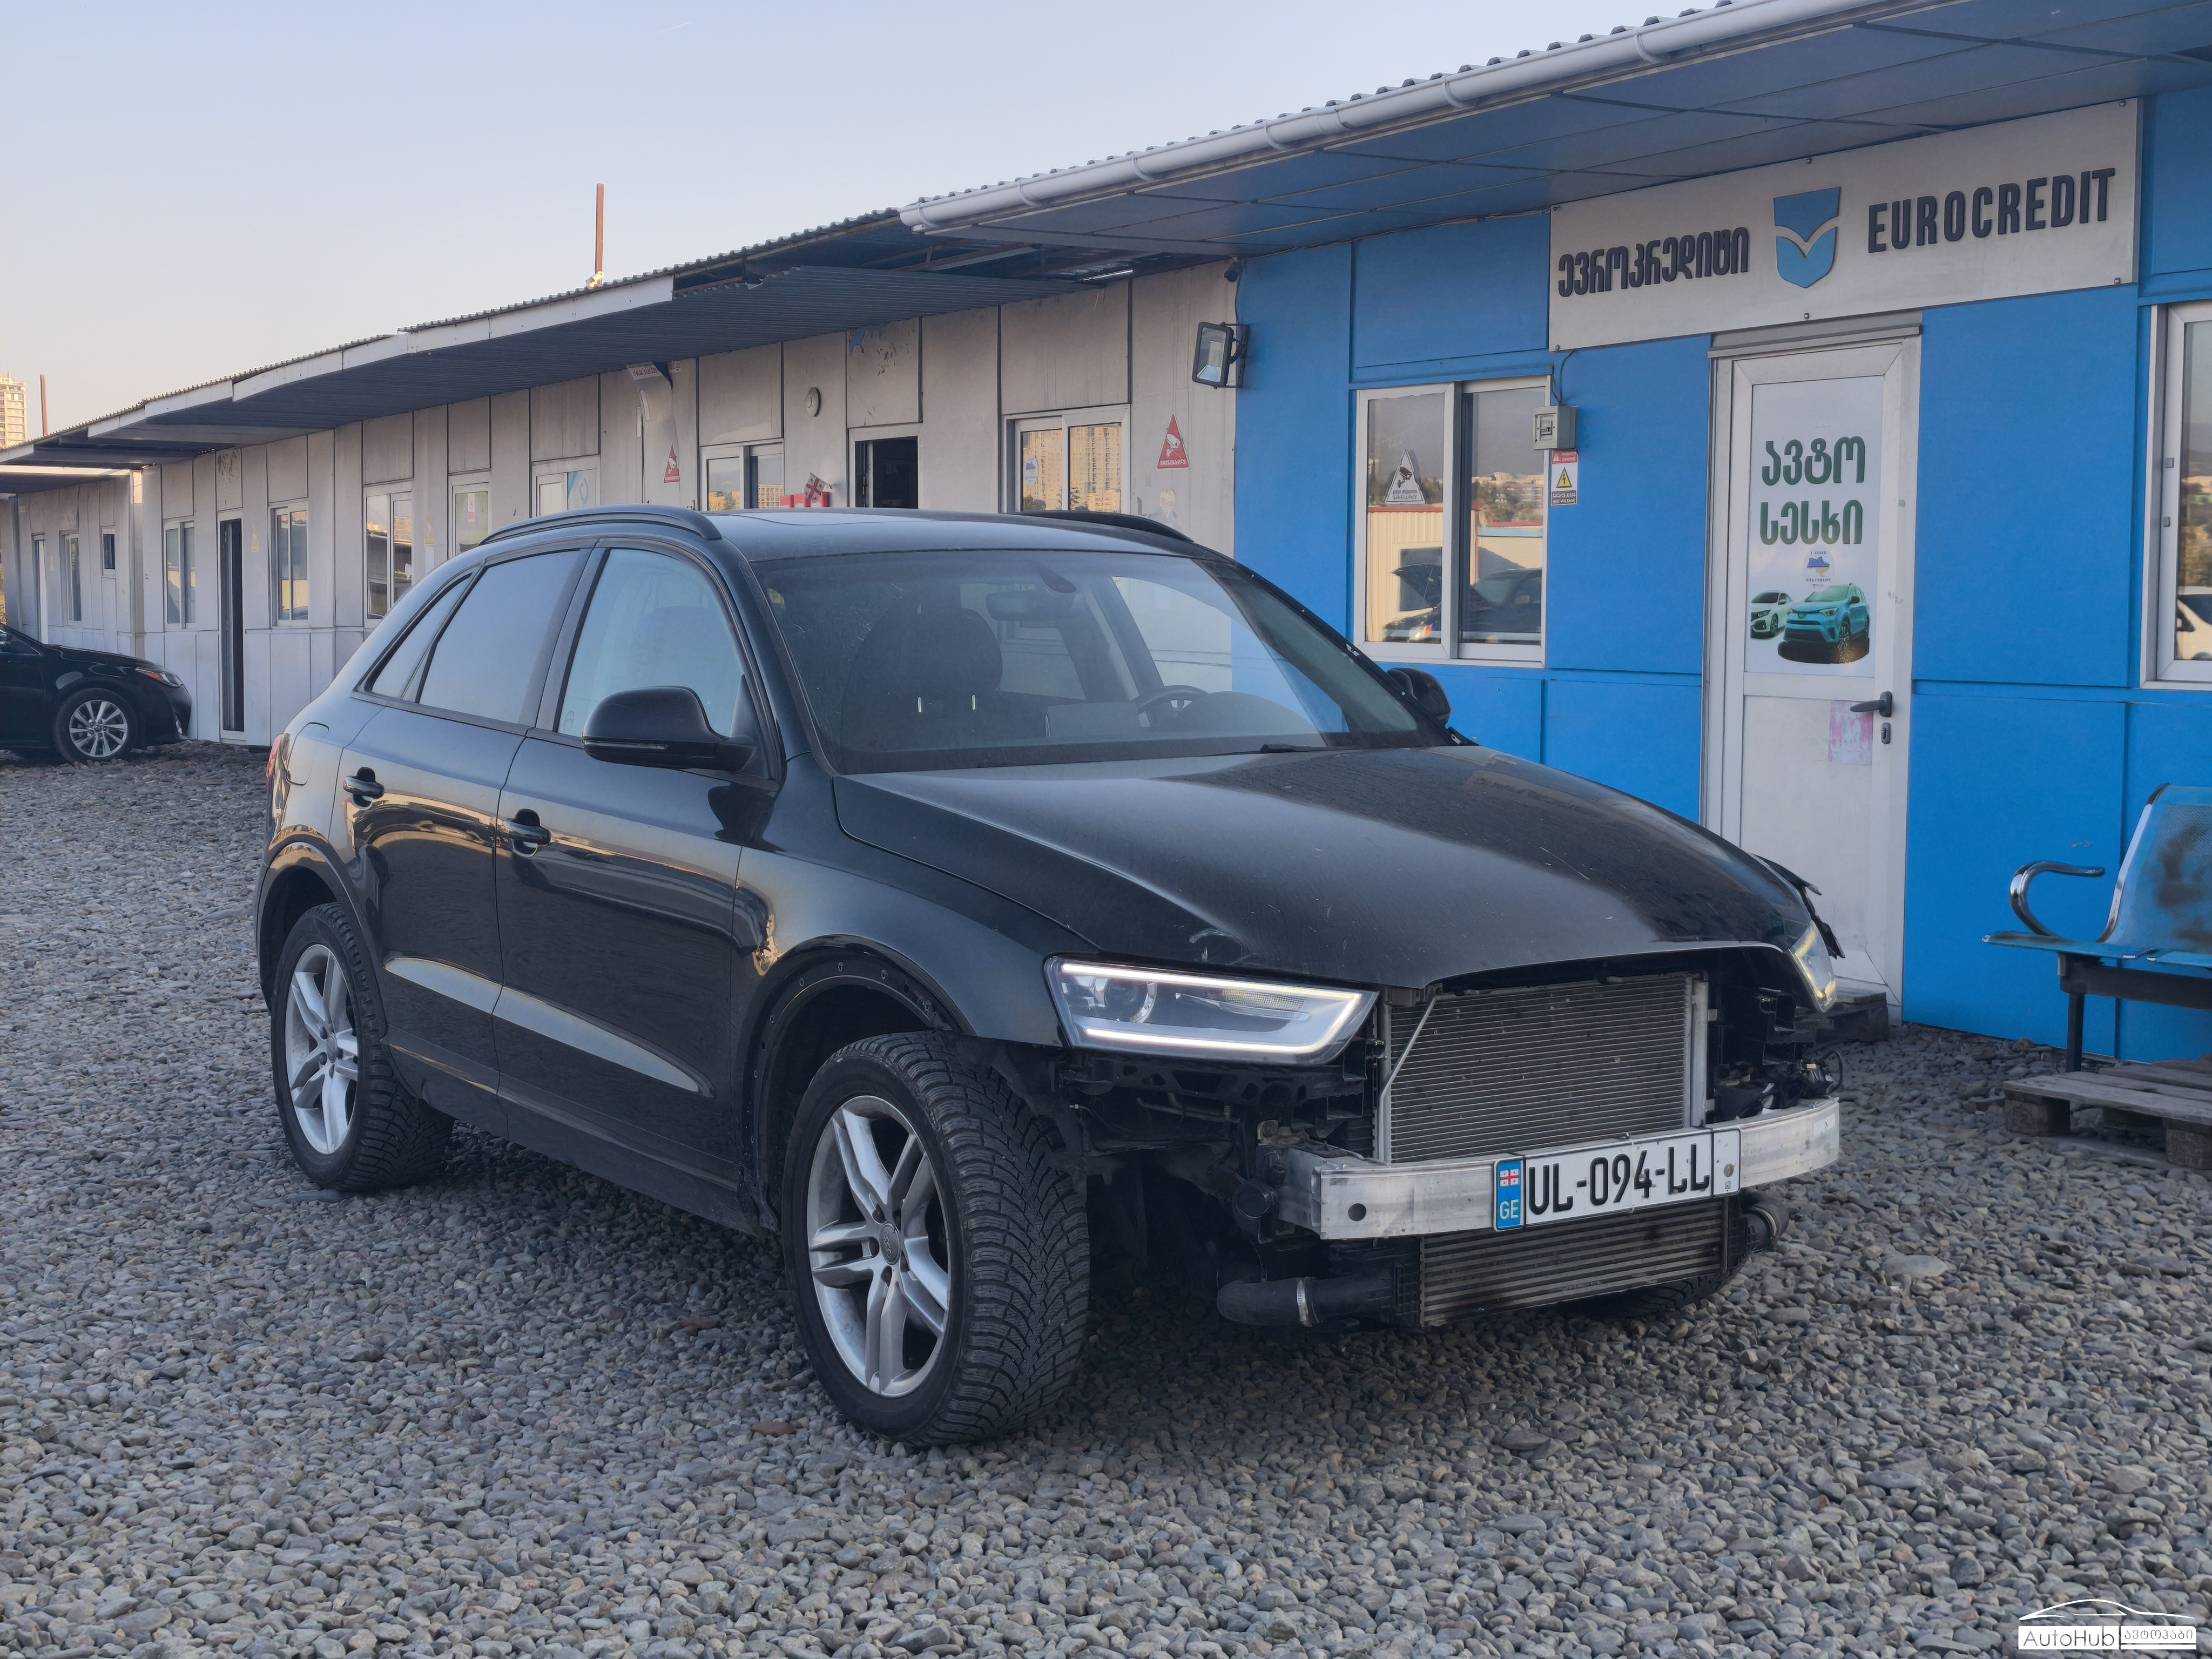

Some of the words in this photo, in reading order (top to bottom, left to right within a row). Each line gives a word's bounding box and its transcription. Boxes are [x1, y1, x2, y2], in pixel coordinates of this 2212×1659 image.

[1868, 167, 2115, 253] EUROCREDIT
[1558, 226, 1749, 298] ევროკრედიტი
[1761, 435, 1866, 487] ავტო
[1759, 499, 1863, 545] სესხი
[1500, 1199, 1519, 1219] GE
[1528, 1143, 1710, 1215] UL-094-LL
